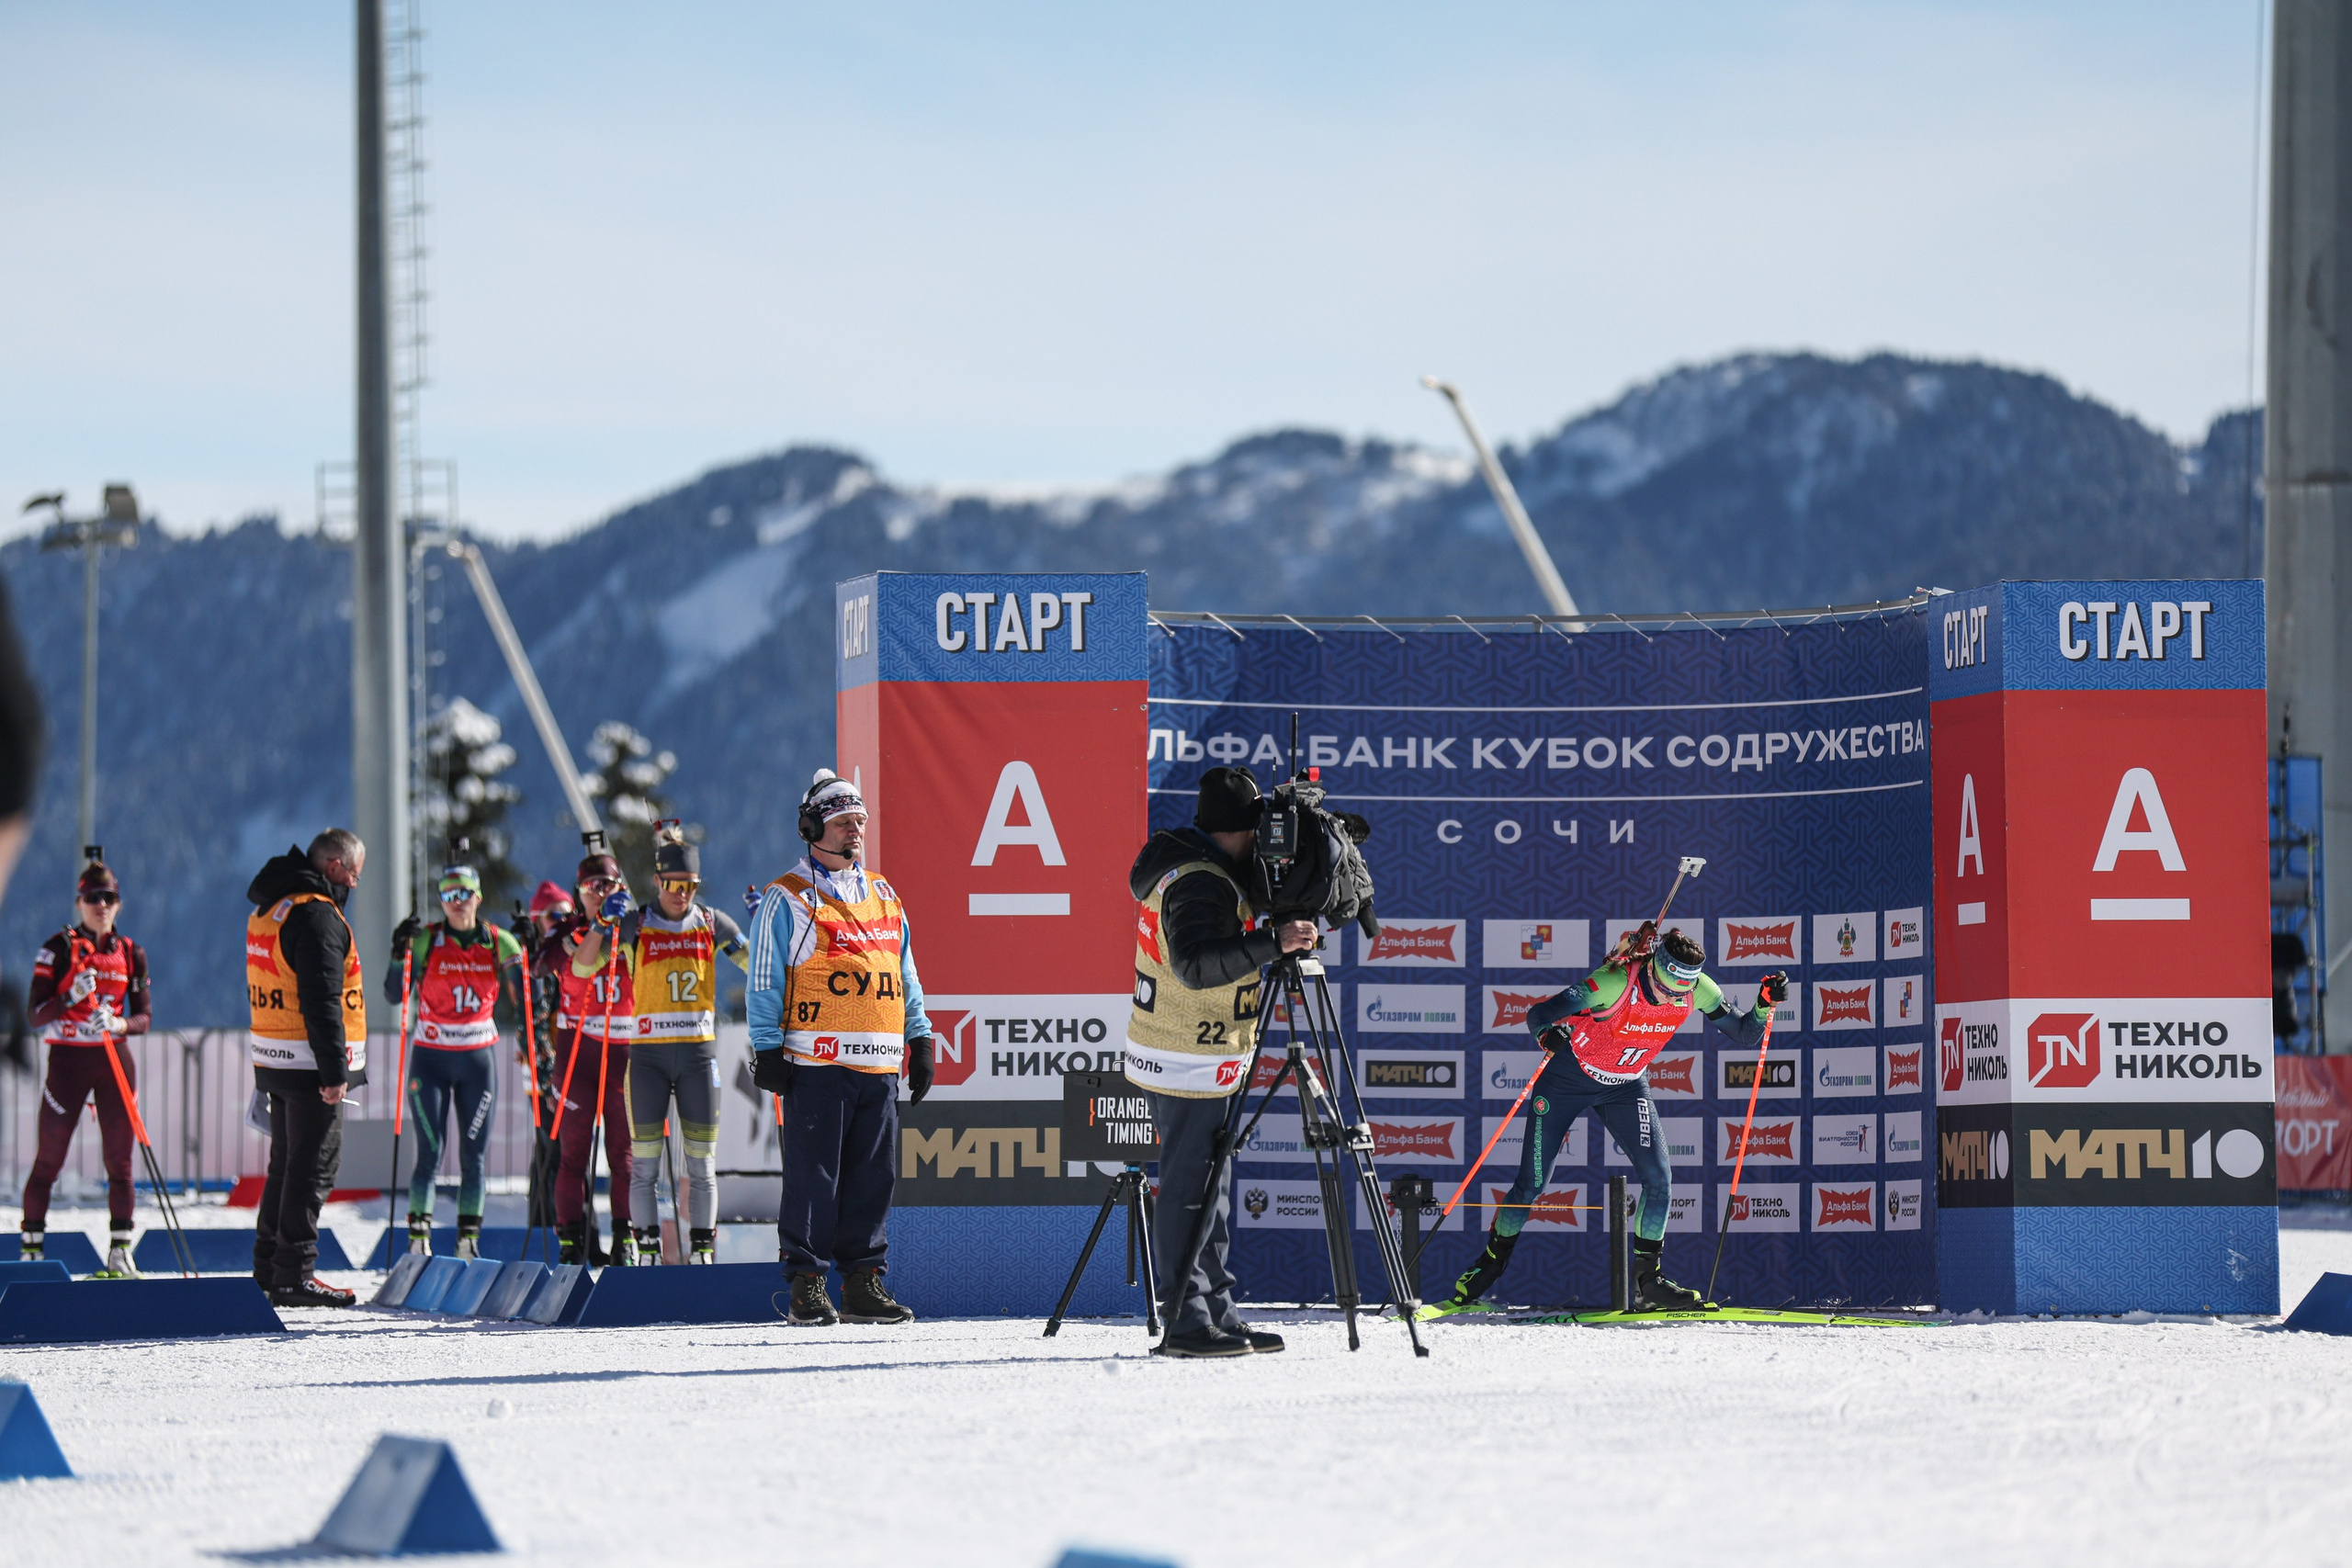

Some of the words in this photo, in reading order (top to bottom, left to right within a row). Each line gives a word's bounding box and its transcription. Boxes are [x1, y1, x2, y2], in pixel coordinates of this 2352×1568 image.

[843, 595, 869, 660] СТАРТ
[935, 592, 1092, 652] СТАРТ
[2059, 601, 2212, 660] СТАРТ
[1943, 605, 1988, 670] СТАРТ
[1472, 736, 1655, 770] КУБОК
[1667, 719, 1925, 773] СОДРУЖЕСТВА
[649, 940, 682, 952] Альфа
[835, 929, 876, 943] Альфа
[1379, 936, 1415, 950] Альфа
[1417, 936, 1445, 947] Банк
[1736, 935, 1764, 948] Альфа
[1766, 934, 1787, 945] Банк
[593, 975, 621, 1004] 13
[666, 971, 697, 1002] 12
[452, 985, 481, 1013] 14
[1826, 998, 1849, 1011] Альфа
[1849, 998, 1866, 1009] Банк
[797, 1001, 820, 1022] 87
[1383, 1011, 1421, 1022] ГАЗПРОМ
[1424, 1011, 1456, 1022] ПОЛЯНА
[984, 1018, 1107, 1043] ТЕХНО
[1196, 1021, 1227, 1045] 22
[1574, 1032, 1590, 1047] 11
[1965, 1023, 1998, 1049] ТЕХНО
[2108, 1021, 2229, 1046] ТЕХНО
[1617, 1047, 1649, 1066] 11
[2115, 1054, 2262, 1079] НИКОЛЬ
[1370, 1065, 1424, 1083] МАТЧ
[1660, 1068, 1685, 1079] Банк
[1893, 1063, 1907, 1076] Альфа
[1967, 1055, 2007, 1081] НИКОЛЬ
[1105, 1122, 1153, 1145] TIMING
[1377, 1133, 1414, 1146] Альфа
[1416, 1133, 1443, 1145] Банк
[1735, 1134, 1764, 1147] Аьфа
[1766, 1134, 1786, 1145] Банк
[901, 1127, 1060, 1179] МАТЧ
[1261, 1141, 1297, 1152] ГАЗПРОМ
[1942, 1131, 1989, 1181] МАТЧ
[2030, 1129, 2186, 1179] МАТЧ
[1276, 1194, 1323, 1204] МИНСПО
[1751, 1198, 1782, 1207] ТЕХНО
[1826, 1201, 1850, 1213] Альфа
[1851, 1200, 1867, 1211] Банк
[1276, 1207, 1318, 1216] РОССИИ
[1752, 1209, 1790, 1218] НИКОЛЬ
